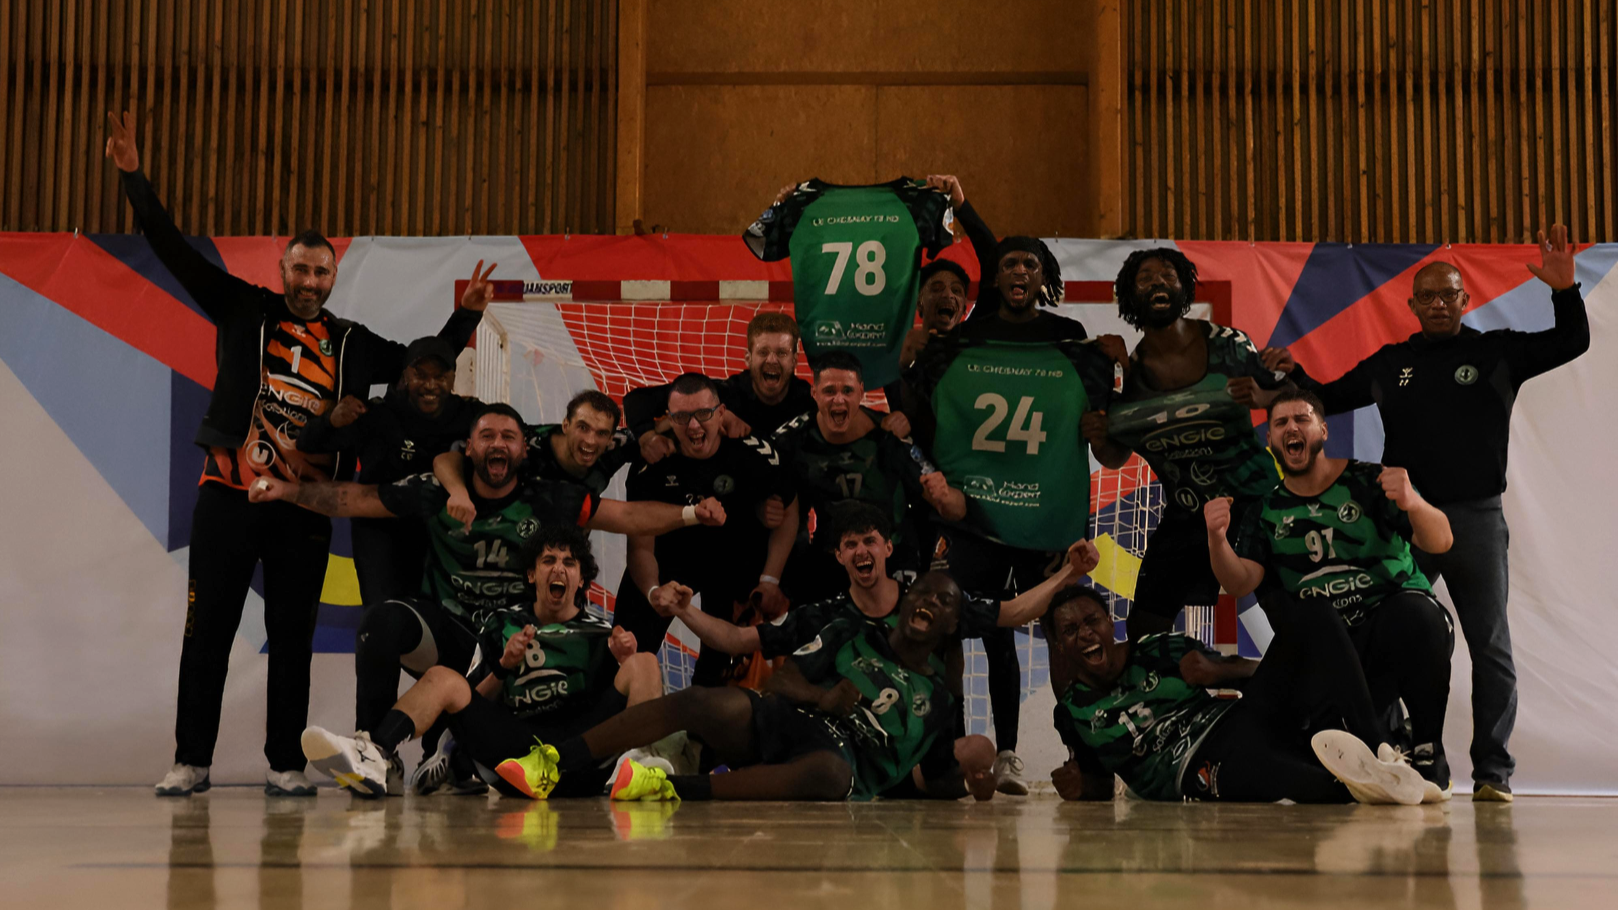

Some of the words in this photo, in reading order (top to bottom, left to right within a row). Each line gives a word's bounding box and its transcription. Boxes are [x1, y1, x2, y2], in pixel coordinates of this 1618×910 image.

[821, 240, 887, 296] 78
[290, 345, 303, 374] 1
[971, 392, 1048, 456] 24
[835, 473, 863, 498] 17
[473, 539, 509, 569] 14
[1118, 701, 1155, 739] 13
